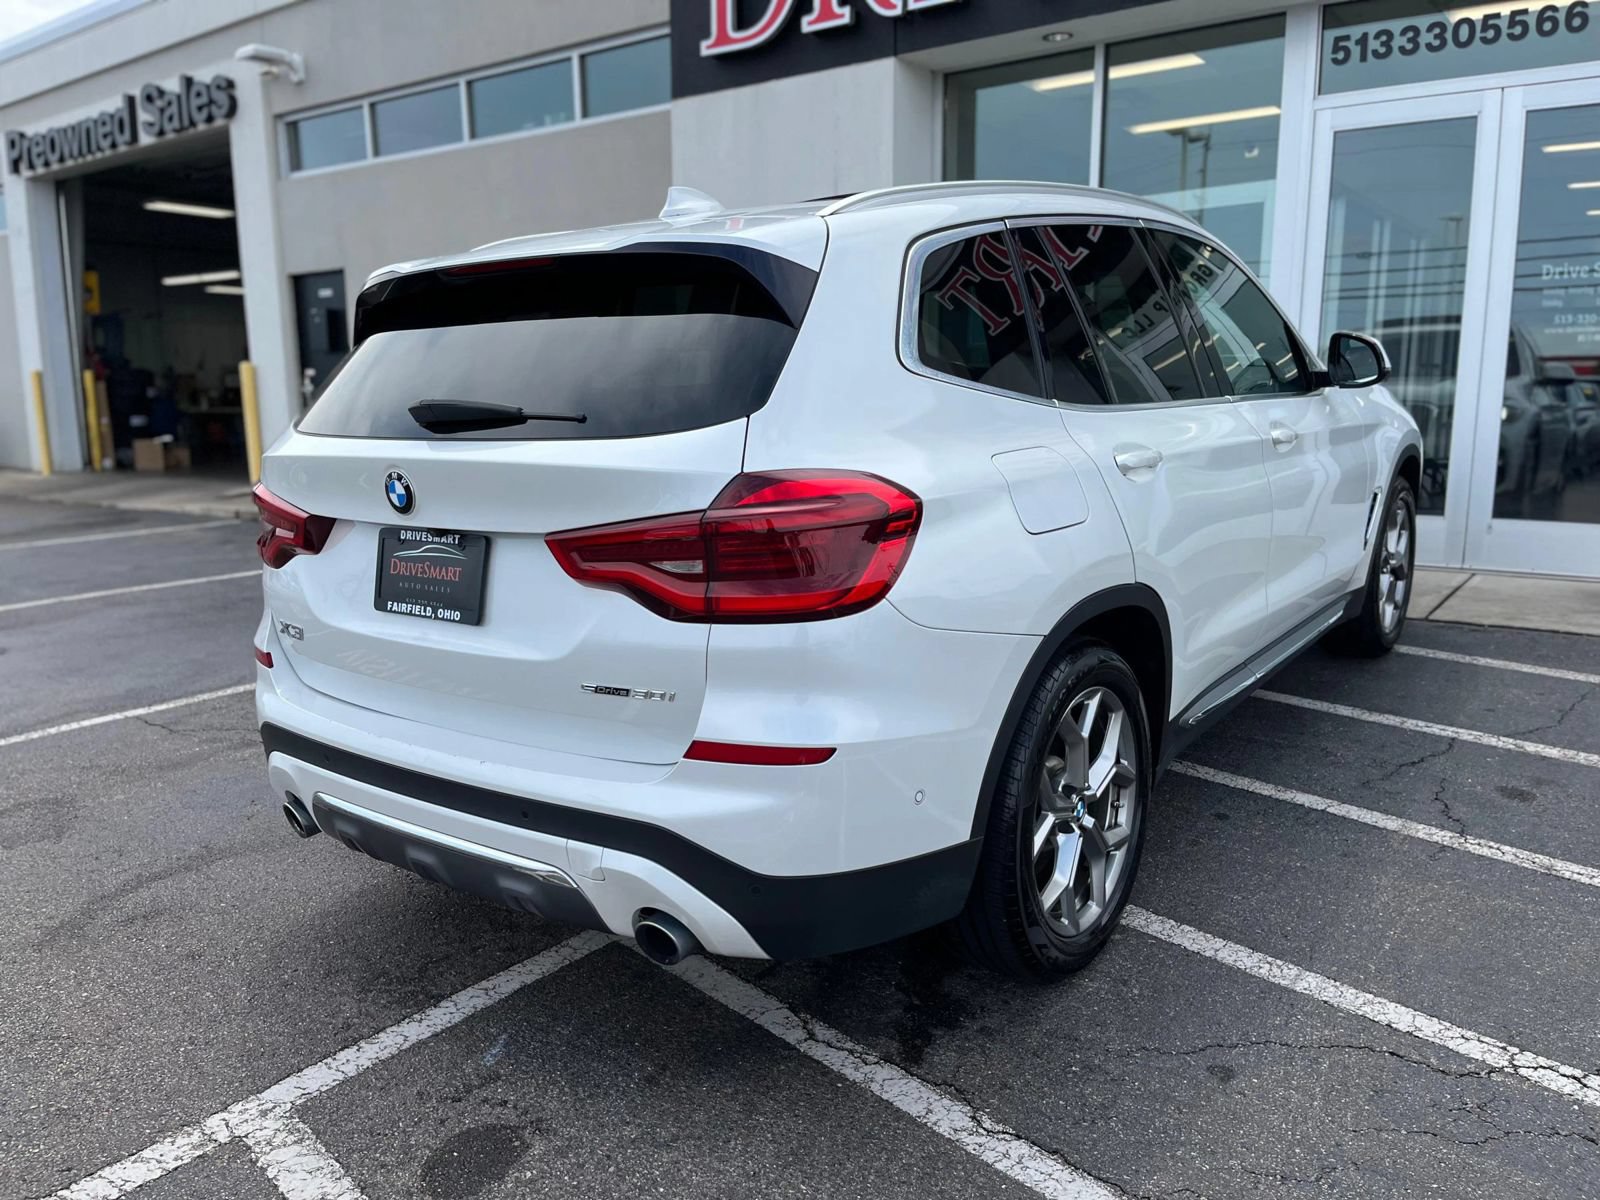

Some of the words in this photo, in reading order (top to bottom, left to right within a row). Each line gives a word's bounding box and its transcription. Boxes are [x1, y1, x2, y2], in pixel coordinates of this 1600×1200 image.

[1330, 0, 1590, 66] 5133305566
[6, 94, 138, 175] Preowned
[140, 74, 238, 138] Sales
[1541, 263, 1590, 280] Drive
[387, 601, 435, 620] FAIRFIELD,
[437, 608, 461, 621] OHIO
